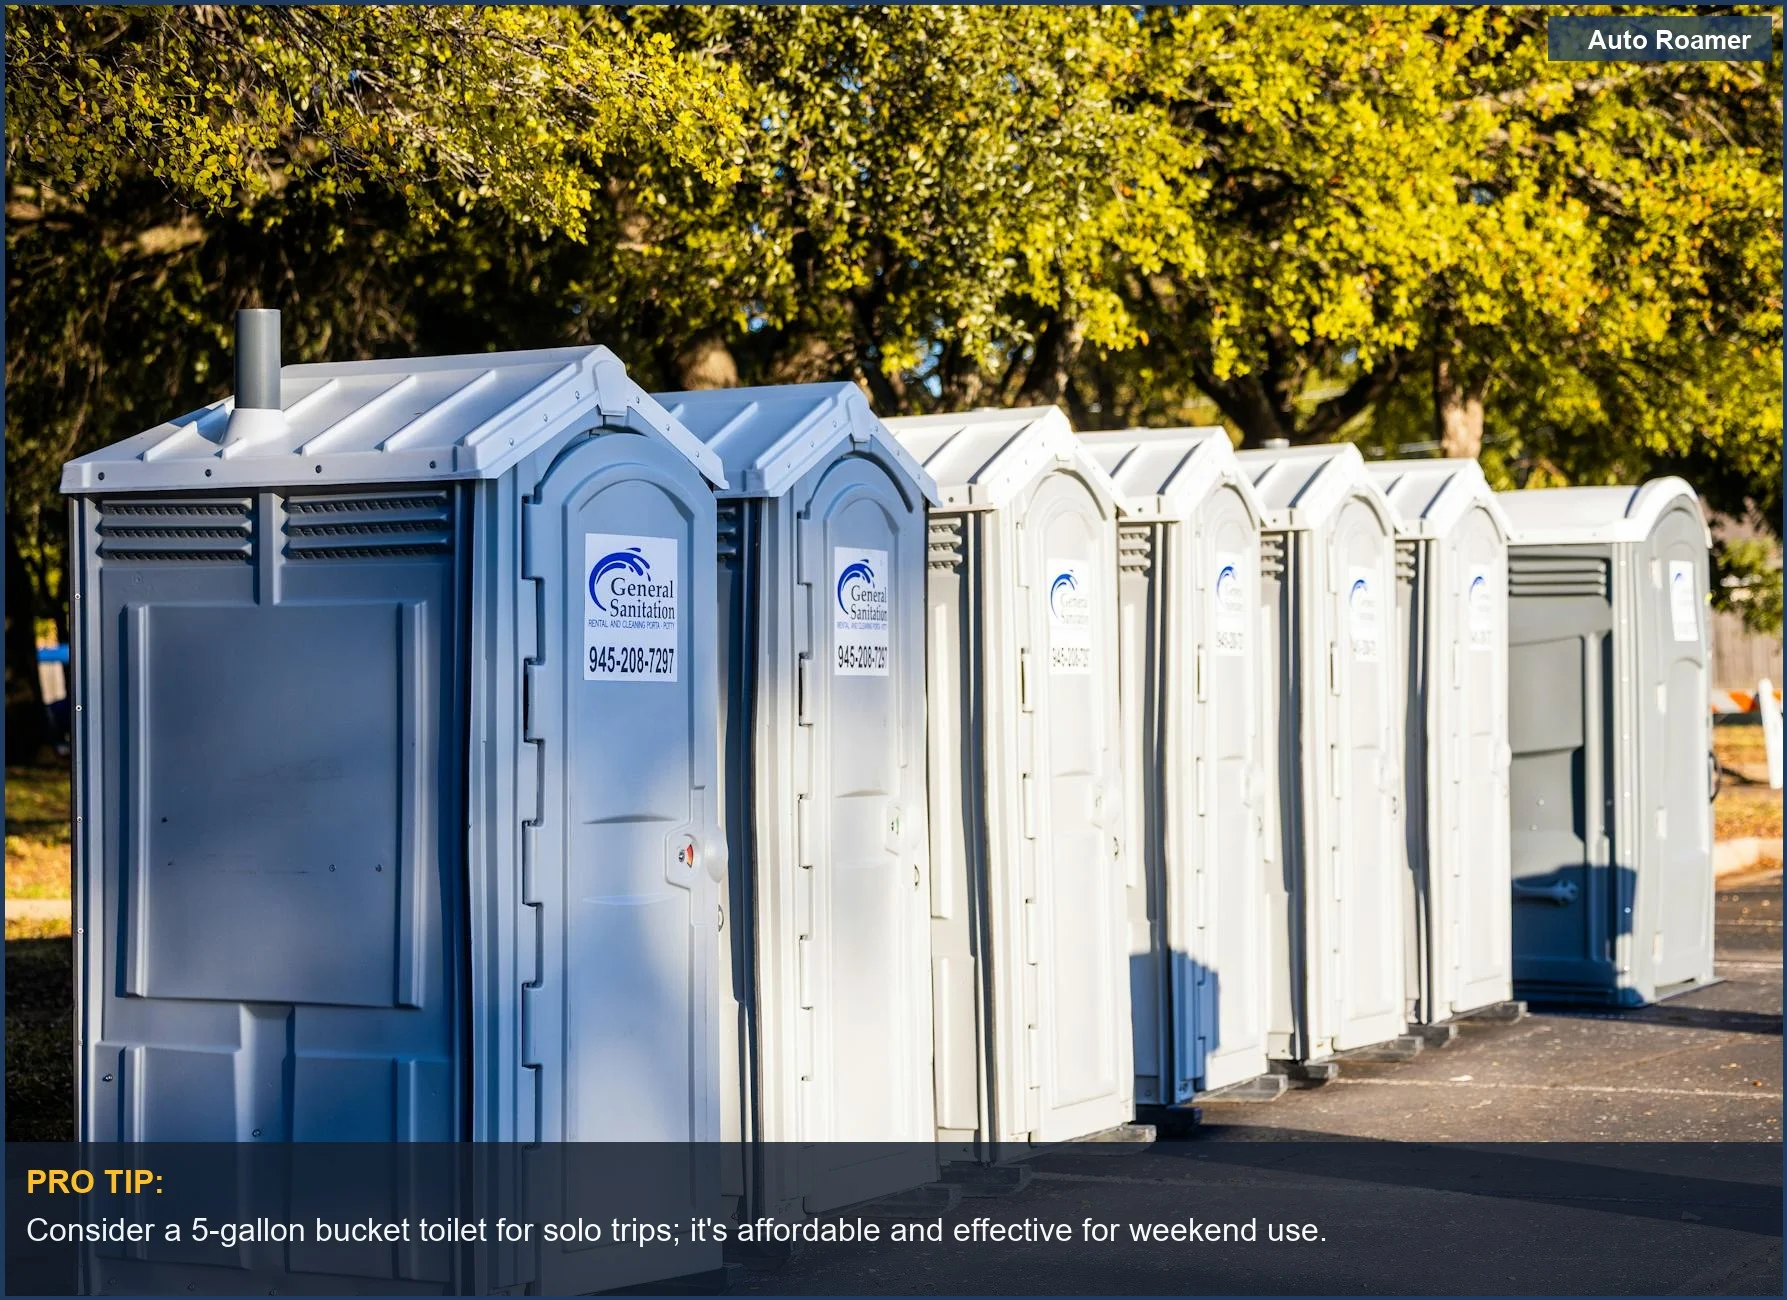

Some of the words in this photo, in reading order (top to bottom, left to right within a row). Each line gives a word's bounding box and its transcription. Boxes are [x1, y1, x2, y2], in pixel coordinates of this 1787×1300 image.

[610, 577, 674, 599] General
[851, 585, 887, 603] General
[610, 598, 675, 620] Sanitation
[850, 603, 888, 621] Sanitation
[588, 619, 608, 628] RENTAL
[610, 619, 621, 629] AND
[622, 620, 646, 630] CLEANING
[589, 646, 675, 674] 945-208-7297
[838, 645, 888, 669] 945-208-7297
